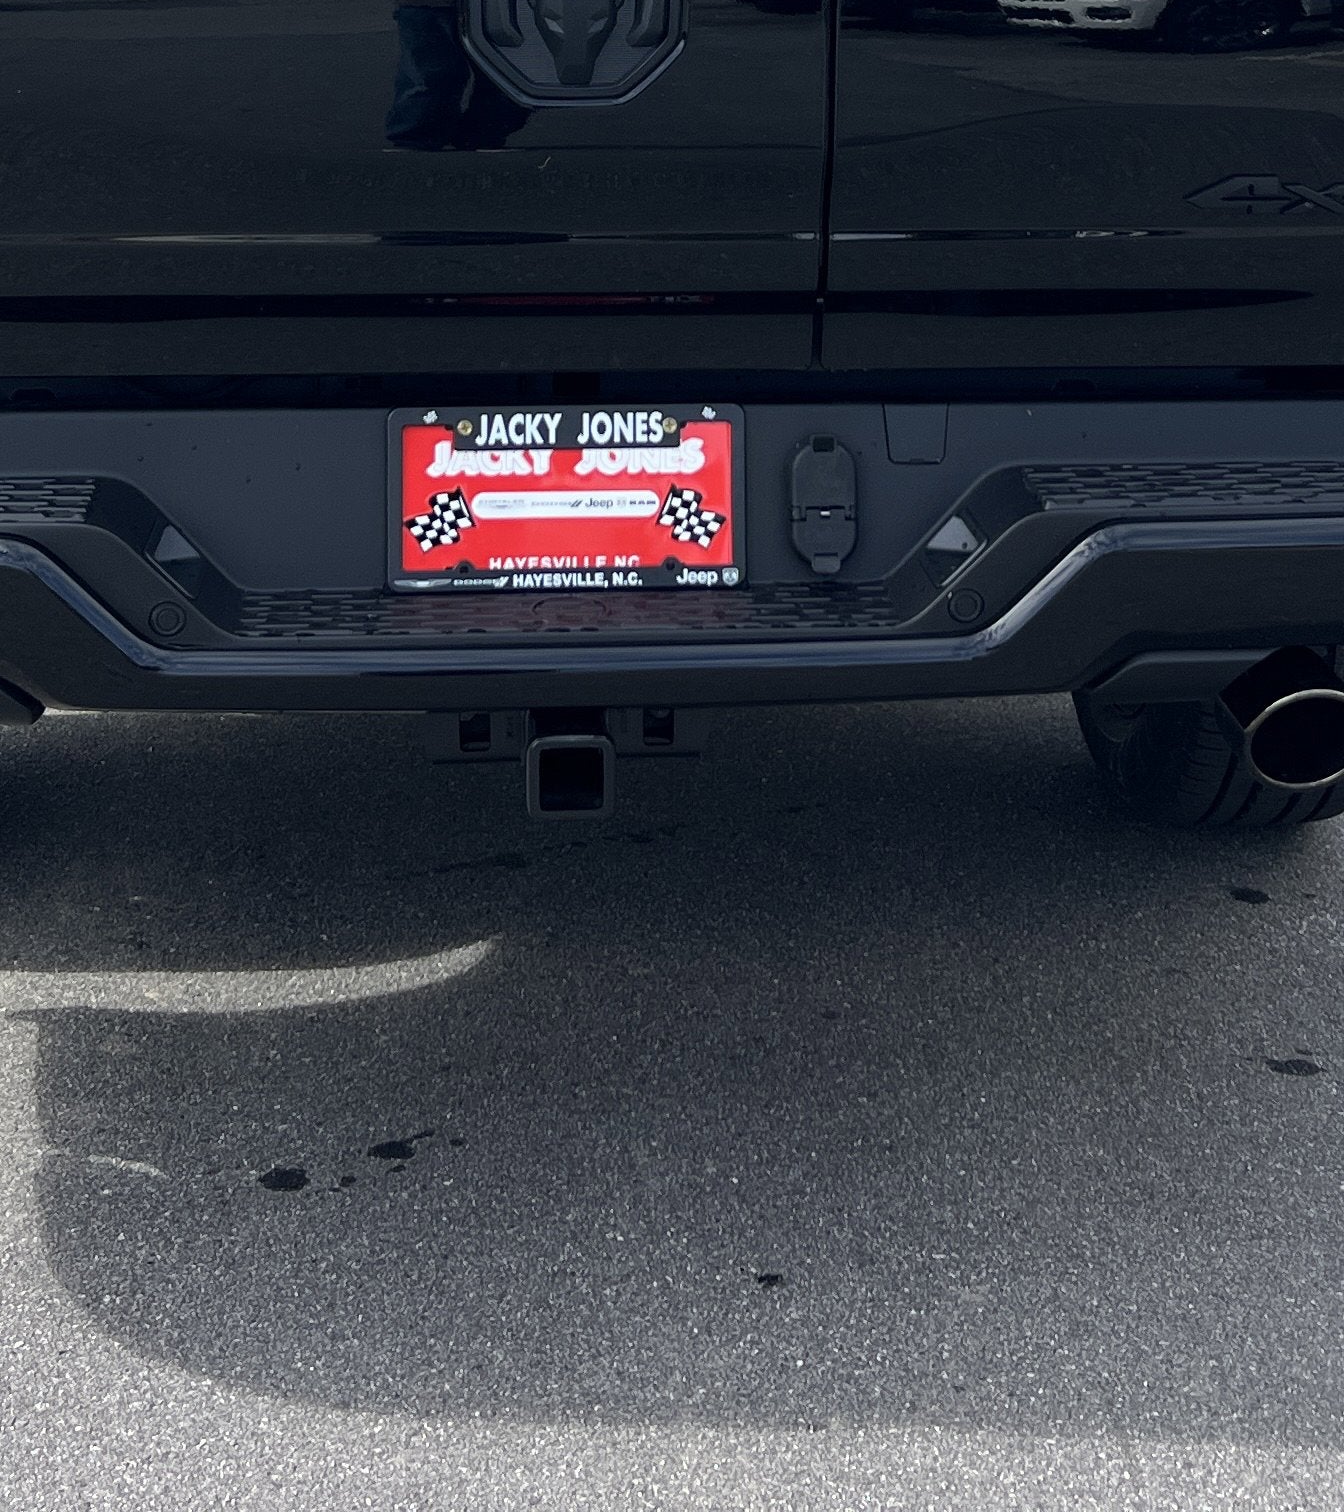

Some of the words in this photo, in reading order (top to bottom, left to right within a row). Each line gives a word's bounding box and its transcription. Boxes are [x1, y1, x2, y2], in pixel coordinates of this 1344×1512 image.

[475, 413, 562, 447] JACKY
[577, 410, 664, 445] JONES
[425, 440, 556, 478] JACKY
[573, 437, 706, 476] JONES
[585, 497, 613, 509] Jeep
[512, 571, 608, 589] HAYESVILLE,
[612, 570, 643, 587] N.C.
[676, 567, 718, 587] Jeep
